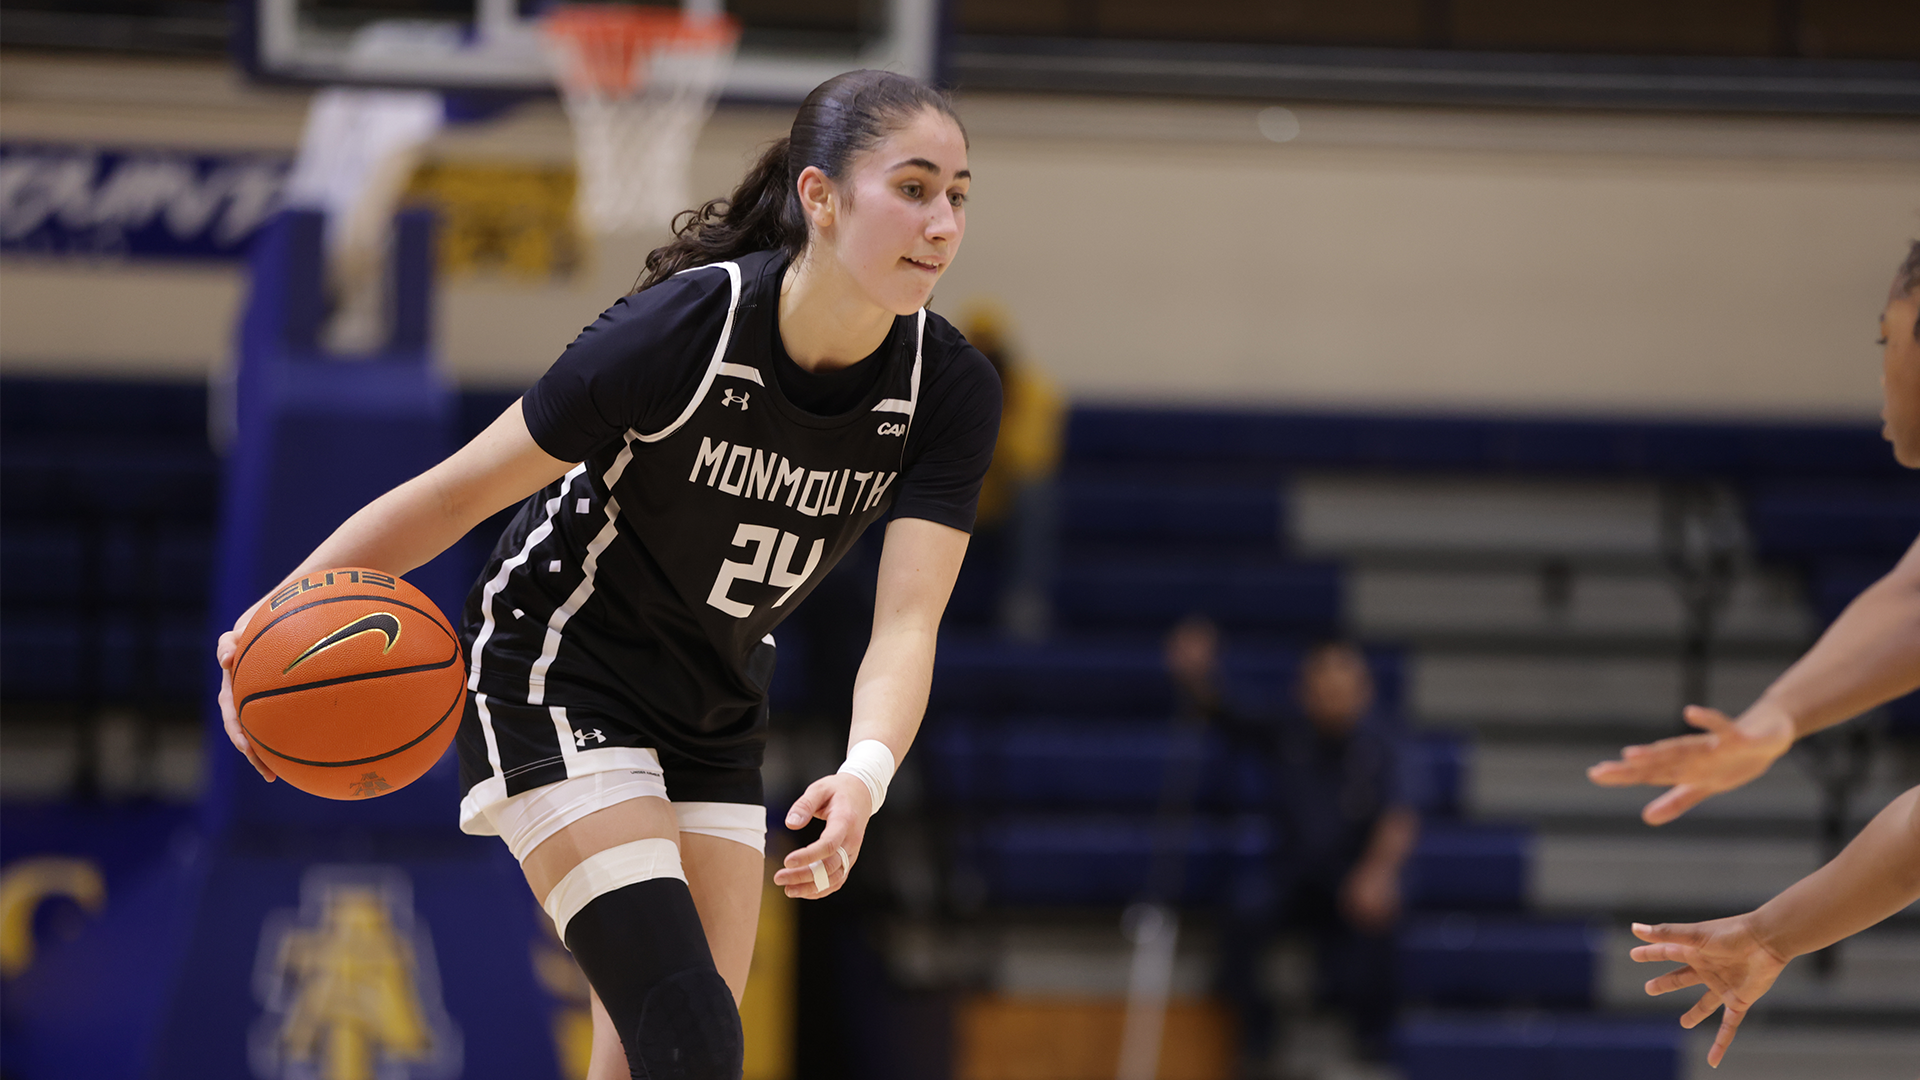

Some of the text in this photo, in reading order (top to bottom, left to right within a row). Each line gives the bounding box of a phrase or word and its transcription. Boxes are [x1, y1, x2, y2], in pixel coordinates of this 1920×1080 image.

[688, 436, 898, 517] MONMOUTH
[270, 570, 396, 612] ELITE
[706, 522, 825, 618] 24
